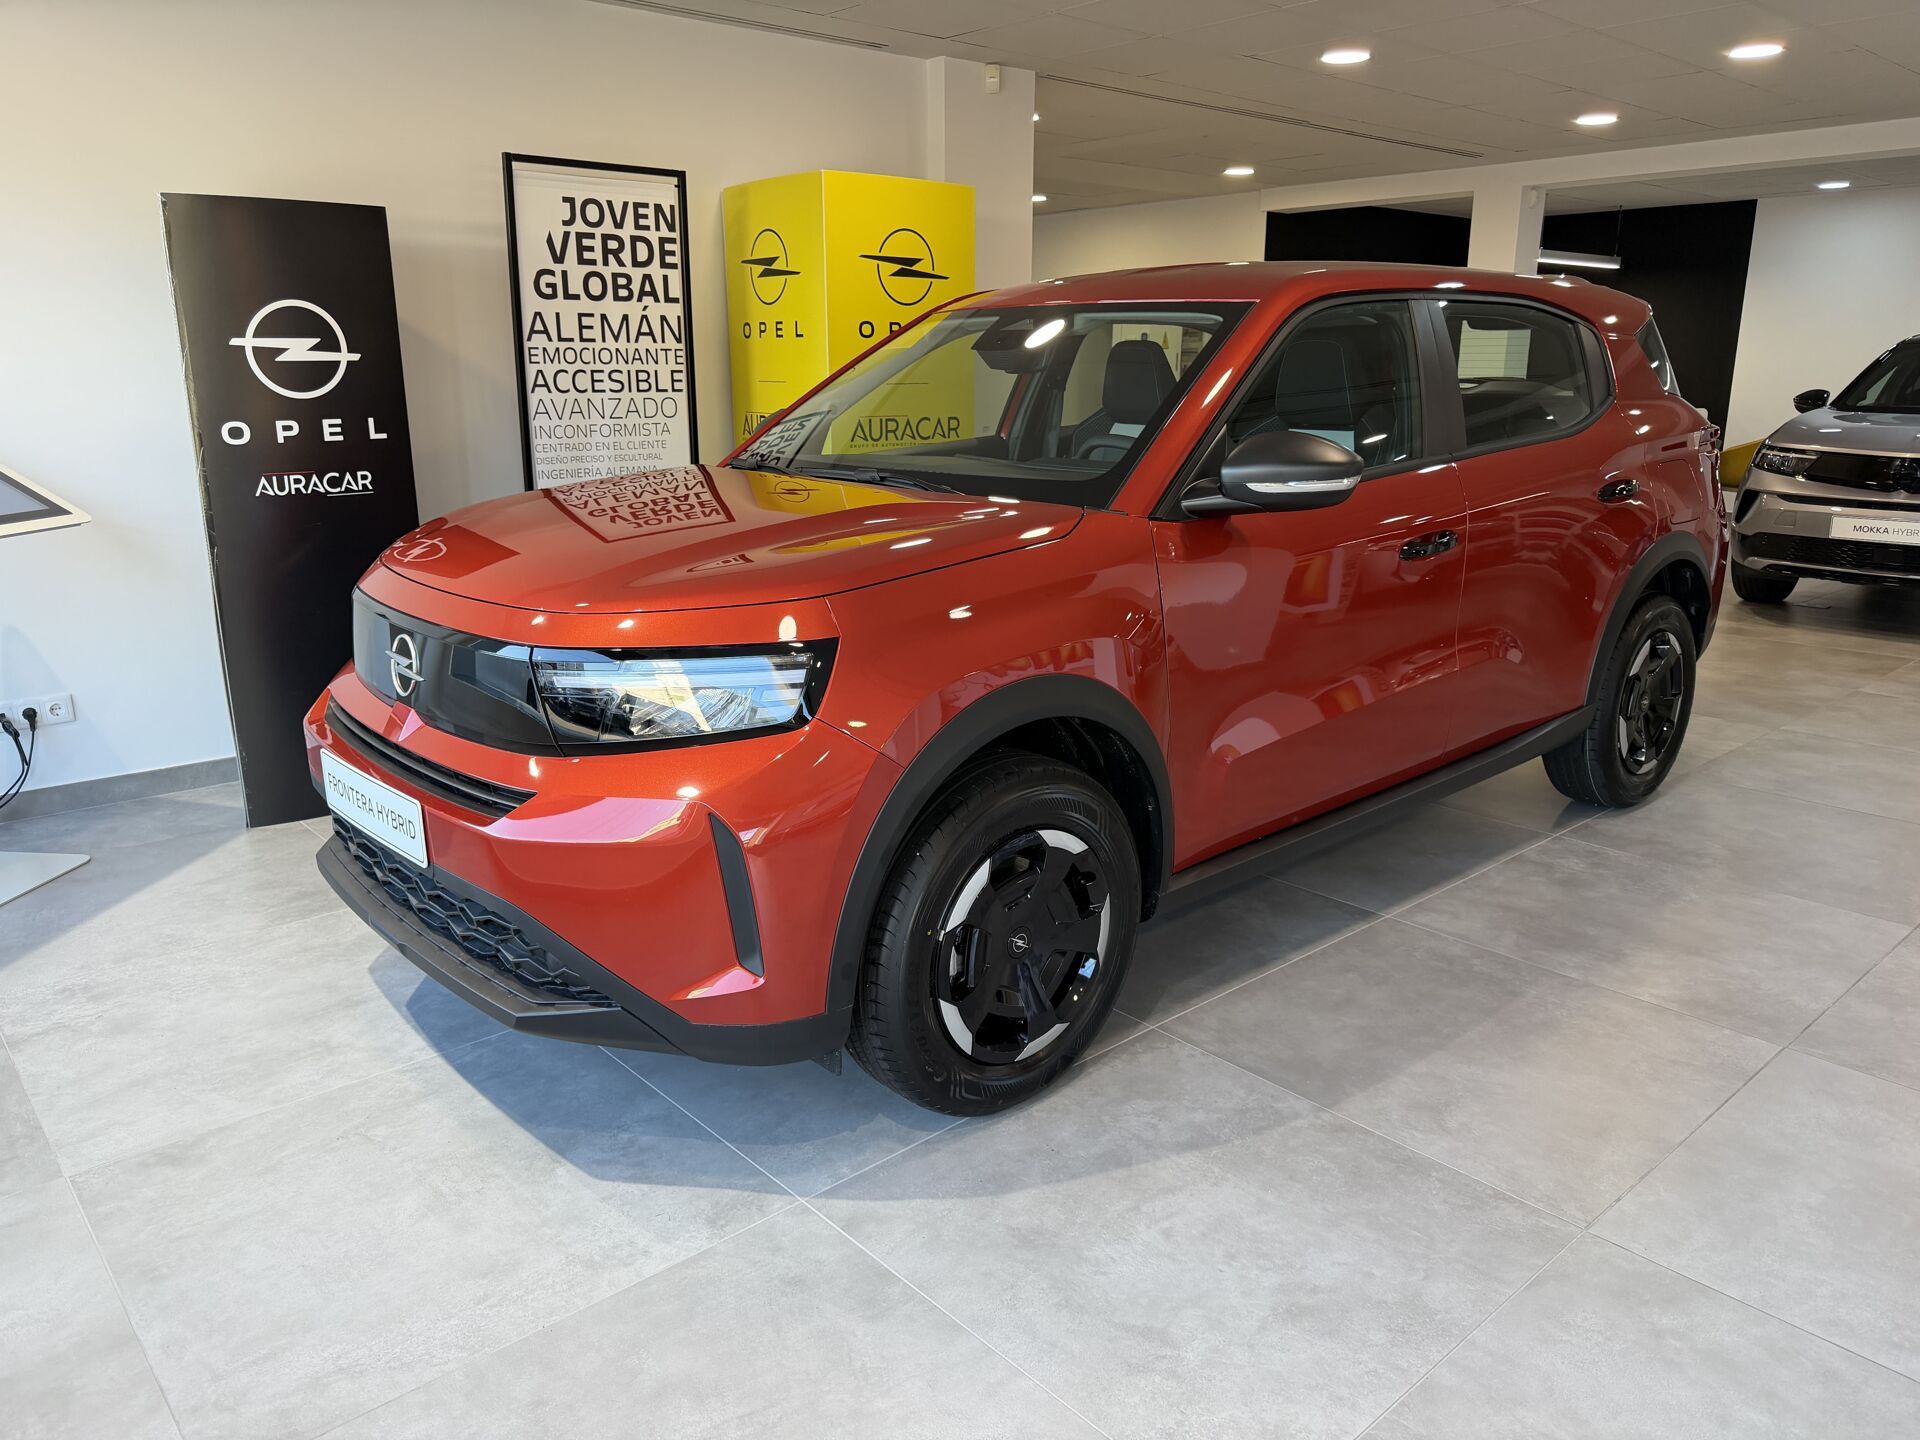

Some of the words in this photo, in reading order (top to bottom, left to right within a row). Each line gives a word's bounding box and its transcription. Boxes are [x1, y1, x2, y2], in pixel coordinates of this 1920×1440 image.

[561, 196, 676, 232] JOVEN
[546, 230, 678, 270] VERDE
[533, 268, 680, 304] GLOBAL
[526, 305, 683, 345] ALEMÁN
[743, 320, 804, 339] OPEL
[859, 321, 902, 338] OP
[528, 346, 684, 366] EMOCIONANTE
[530, 369, 684, 394] ACCESIBLE
[533, 397, 678, 421] AVANZADO
[221, 417, 387, 446] OPEL
[534, 422, 671, 440] INCONFORMISTA
[850, 416, 960, 442] AURACAR
[535, 442, 593, 454] CENTRADO
[595, 442, 610, 451] EN
[613, 441, 625, 451] EL
[627, 440, 667, 450] CLIENTE
[536, 454, 568, 466] DISEÑO
[570, 454, 605, 464] PRECISO
[606, 454, 613, 462] Y
[614, 452, 663, 463] ESCULTURAL
[255, 470, 374, 497] AURACAR
[537, 465, 603, 481] INGENIERÍA
[1853, 525, 1889, 535] MOKKA
[1892, 528, 1920, 537] HYBR
[327, 772, 376, 818] FRONTERA
[376, 802, 416, 840] HYBRID
